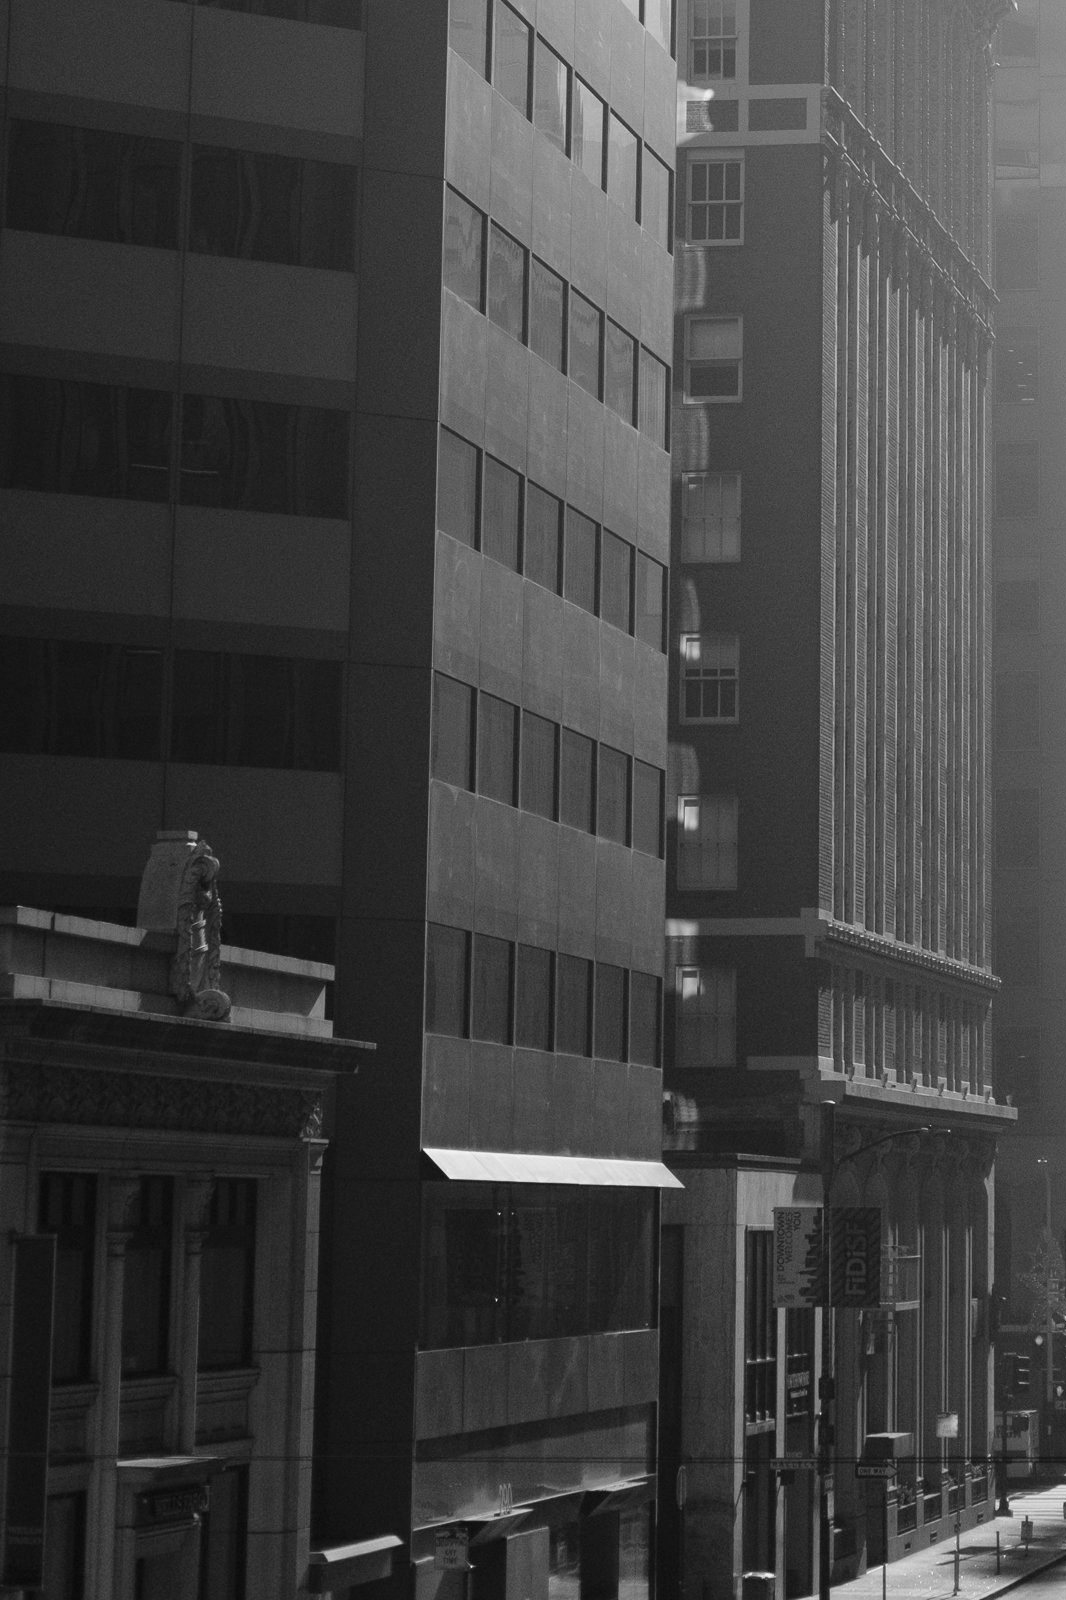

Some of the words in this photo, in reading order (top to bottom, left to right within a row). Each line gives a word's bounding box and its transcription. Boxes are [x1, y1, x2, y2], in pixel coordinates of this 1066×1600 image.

[777, 1212, 785, 1272] DOWNTOWN
[785, 1212, 793, 1264] WELCOMES
[793, 1212, 801, 1232] YOU
